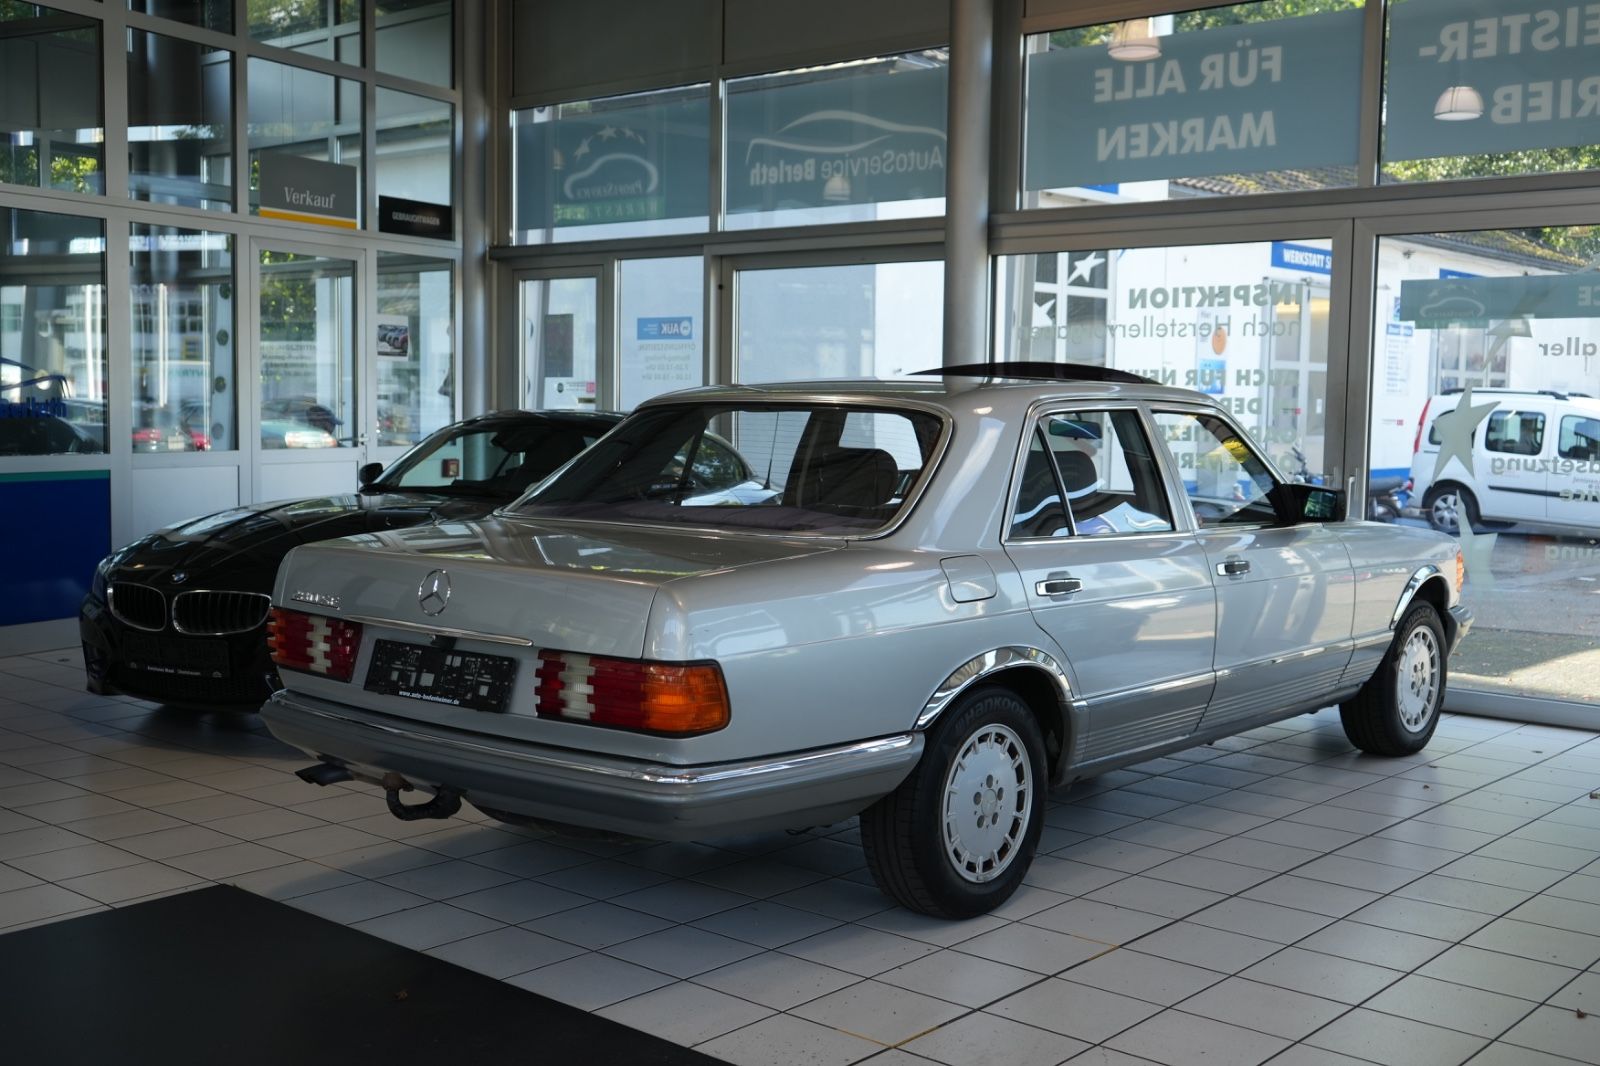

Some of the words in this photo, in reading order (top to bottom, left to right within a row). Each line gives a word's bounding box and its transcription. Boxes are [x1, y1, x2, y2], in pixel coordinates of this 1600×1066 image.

[284, 186, 336, 209] Verkauf
[391, 211, 441, 226] GEBRAUCHTWAGEN
[1283, 248, 1325, 267] WERKSTATT
